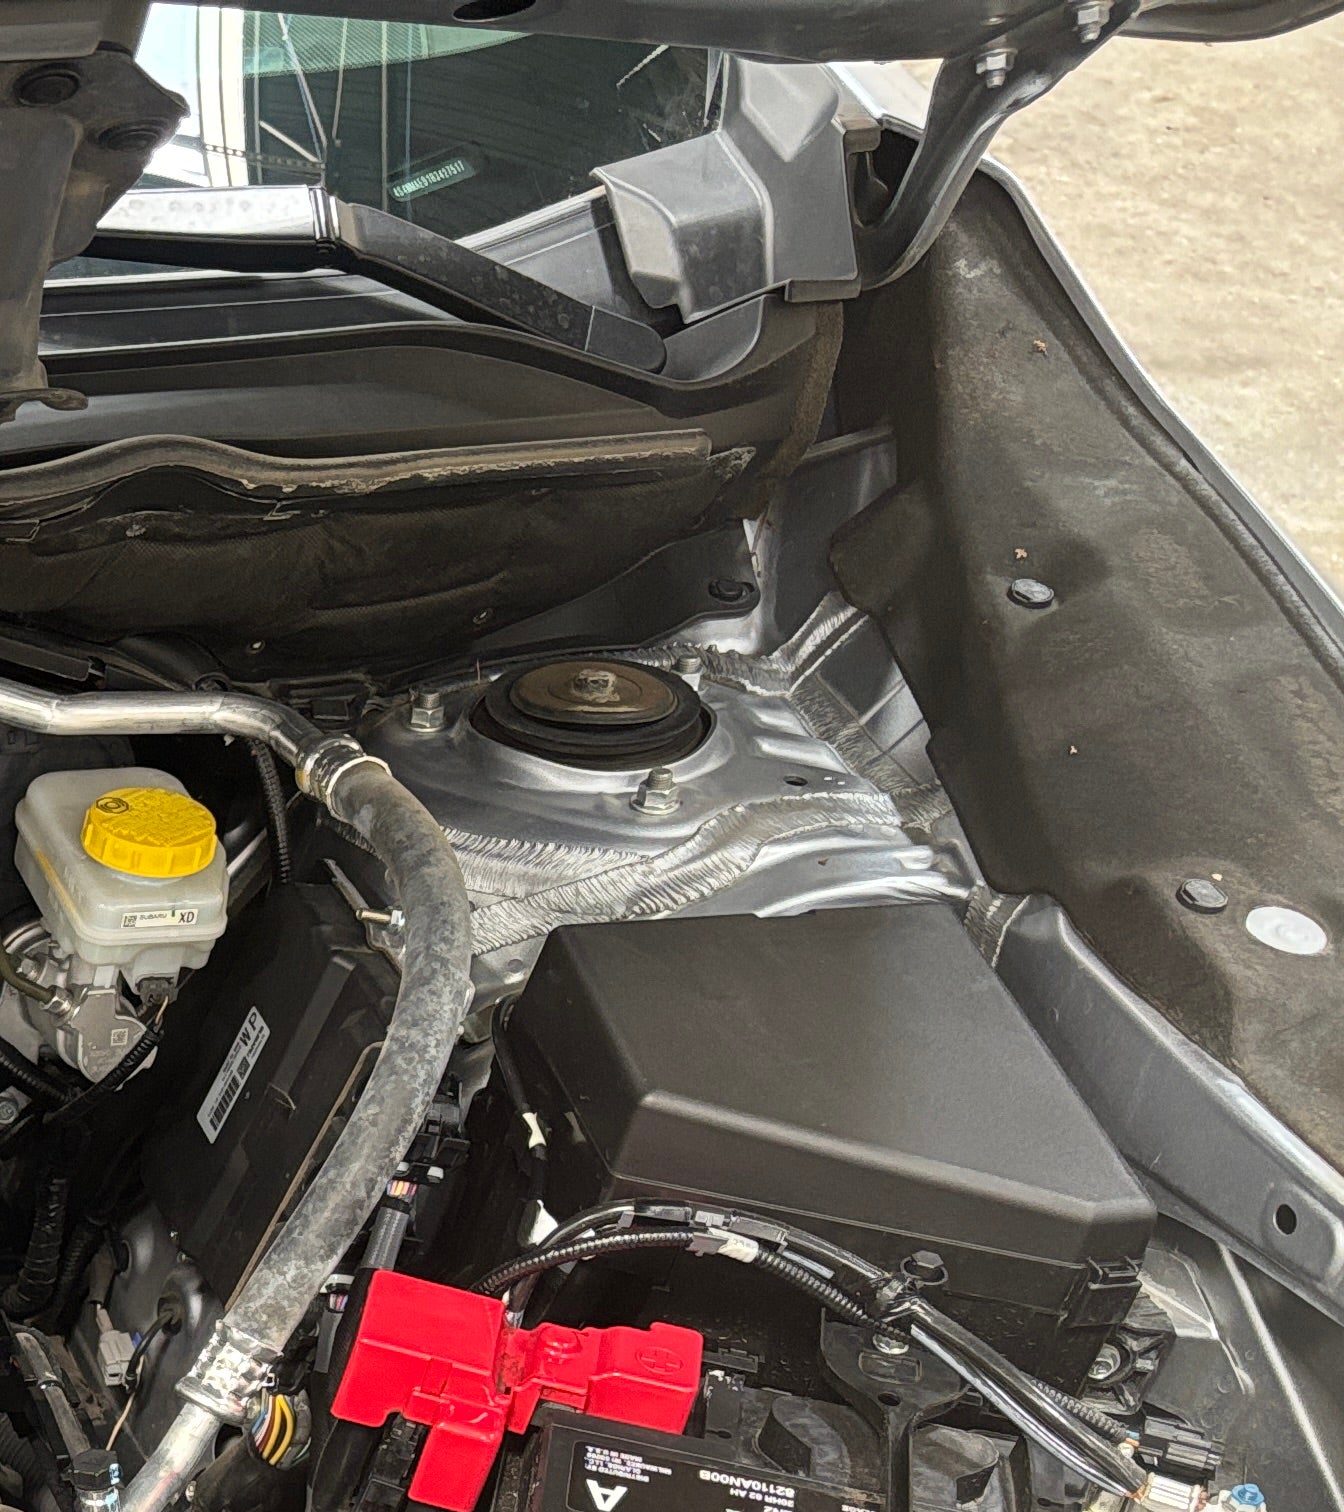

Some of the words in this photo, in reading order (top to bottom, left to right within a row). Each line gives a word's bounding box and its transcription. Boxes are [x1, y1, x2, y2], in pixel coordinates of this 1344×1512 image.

[178, 911, 194, 924] XD
[586, 1478, 628, 1512] A
[699, 1470, 795, 1498] 82110AN00B
